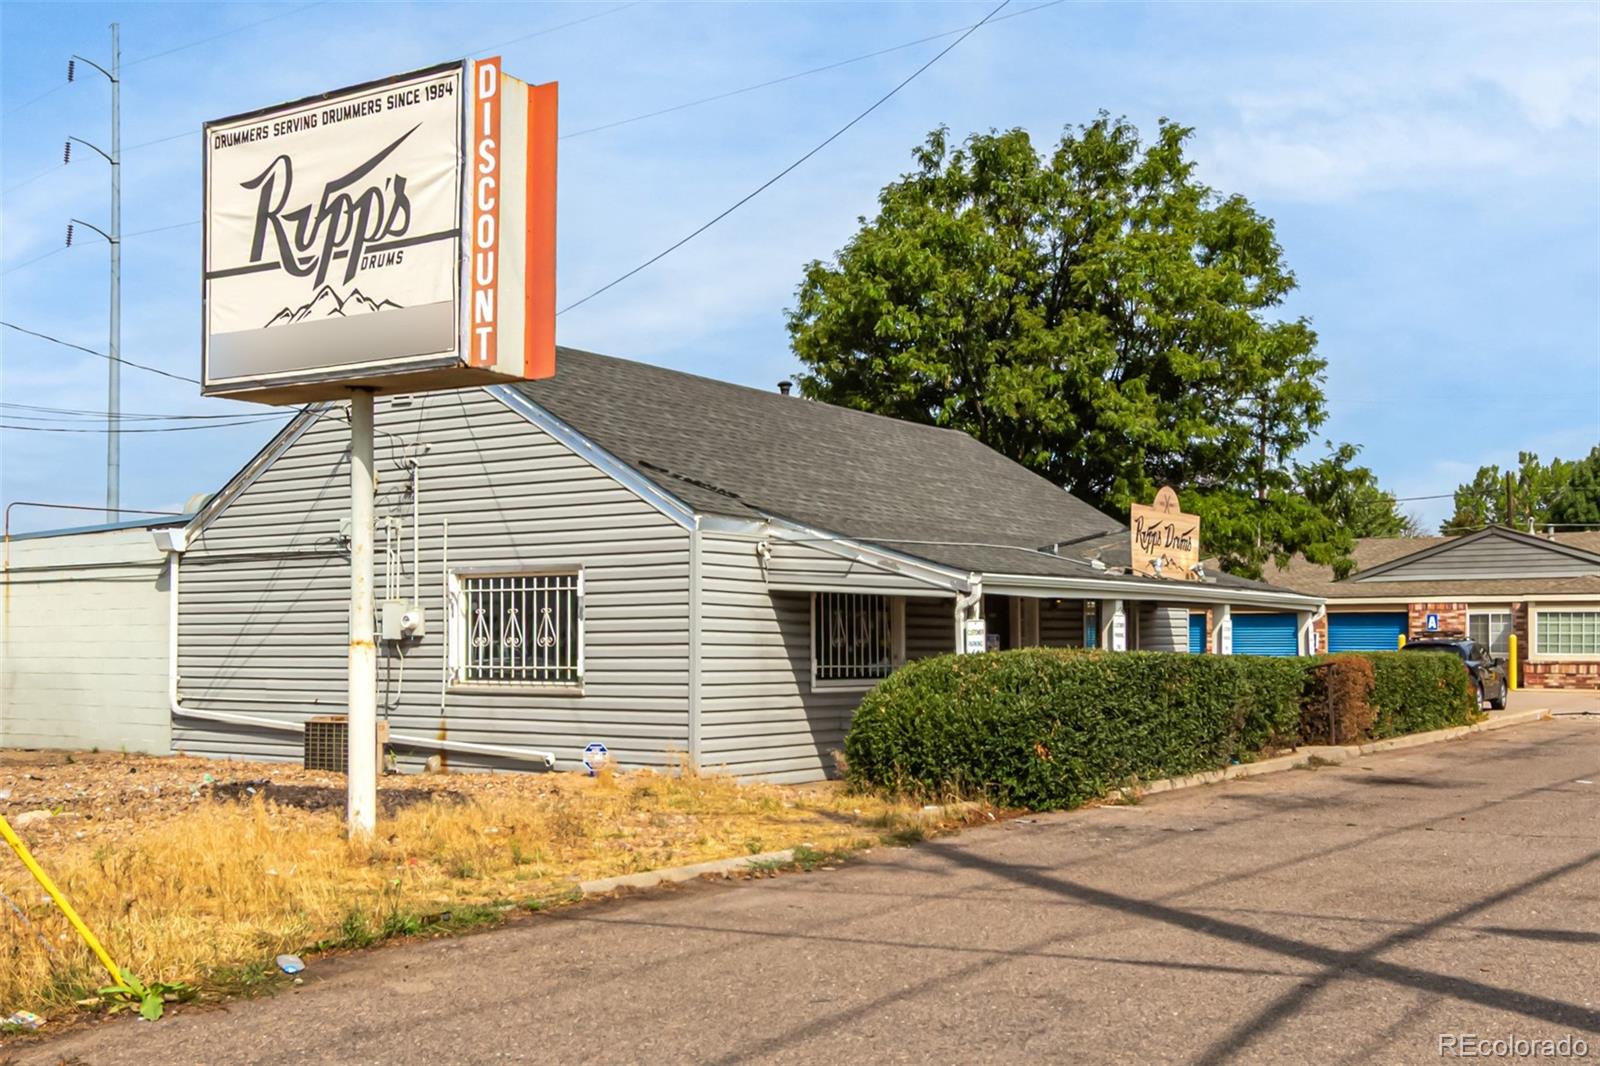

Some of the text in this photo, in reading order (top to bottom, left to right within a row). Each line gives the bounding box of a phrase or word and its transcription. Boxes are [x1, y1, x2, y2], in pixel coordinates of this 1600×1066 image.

[214, 81, 453, 150] DRUMMERS SERVING DRUMMERS SINCE 1984
[239, 121, 424, 291] Rupp's
[475, 63, 497, 361] DISCOUNT
[360, 250, 404, 271] DRUMS
[1164, 523, 1196, 552] Drums
[1428, 615, 1437, 629] A
